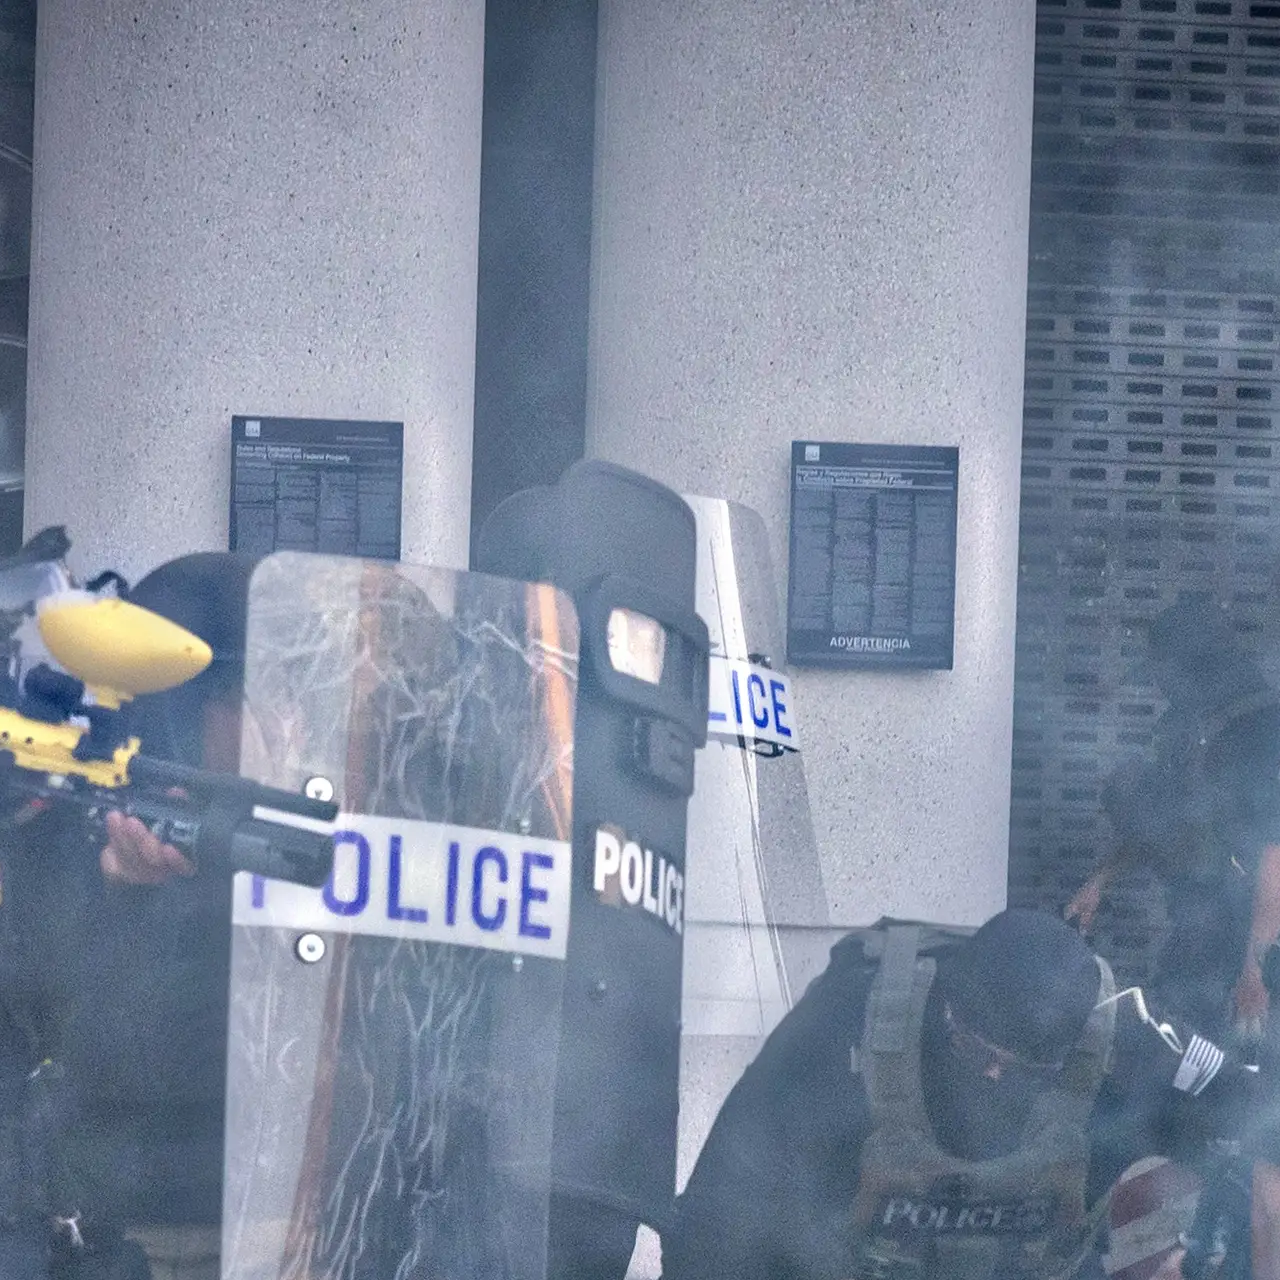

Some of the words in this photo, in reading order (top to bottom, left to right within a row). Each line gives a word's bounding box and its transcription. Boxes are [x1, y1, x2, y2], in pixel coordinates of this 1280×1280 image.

[830, 636, 911, 649] ADVERTENCIA
[708, 669, 792, 737] ICE
[883, 1198, 1015, 1230] POLICE
